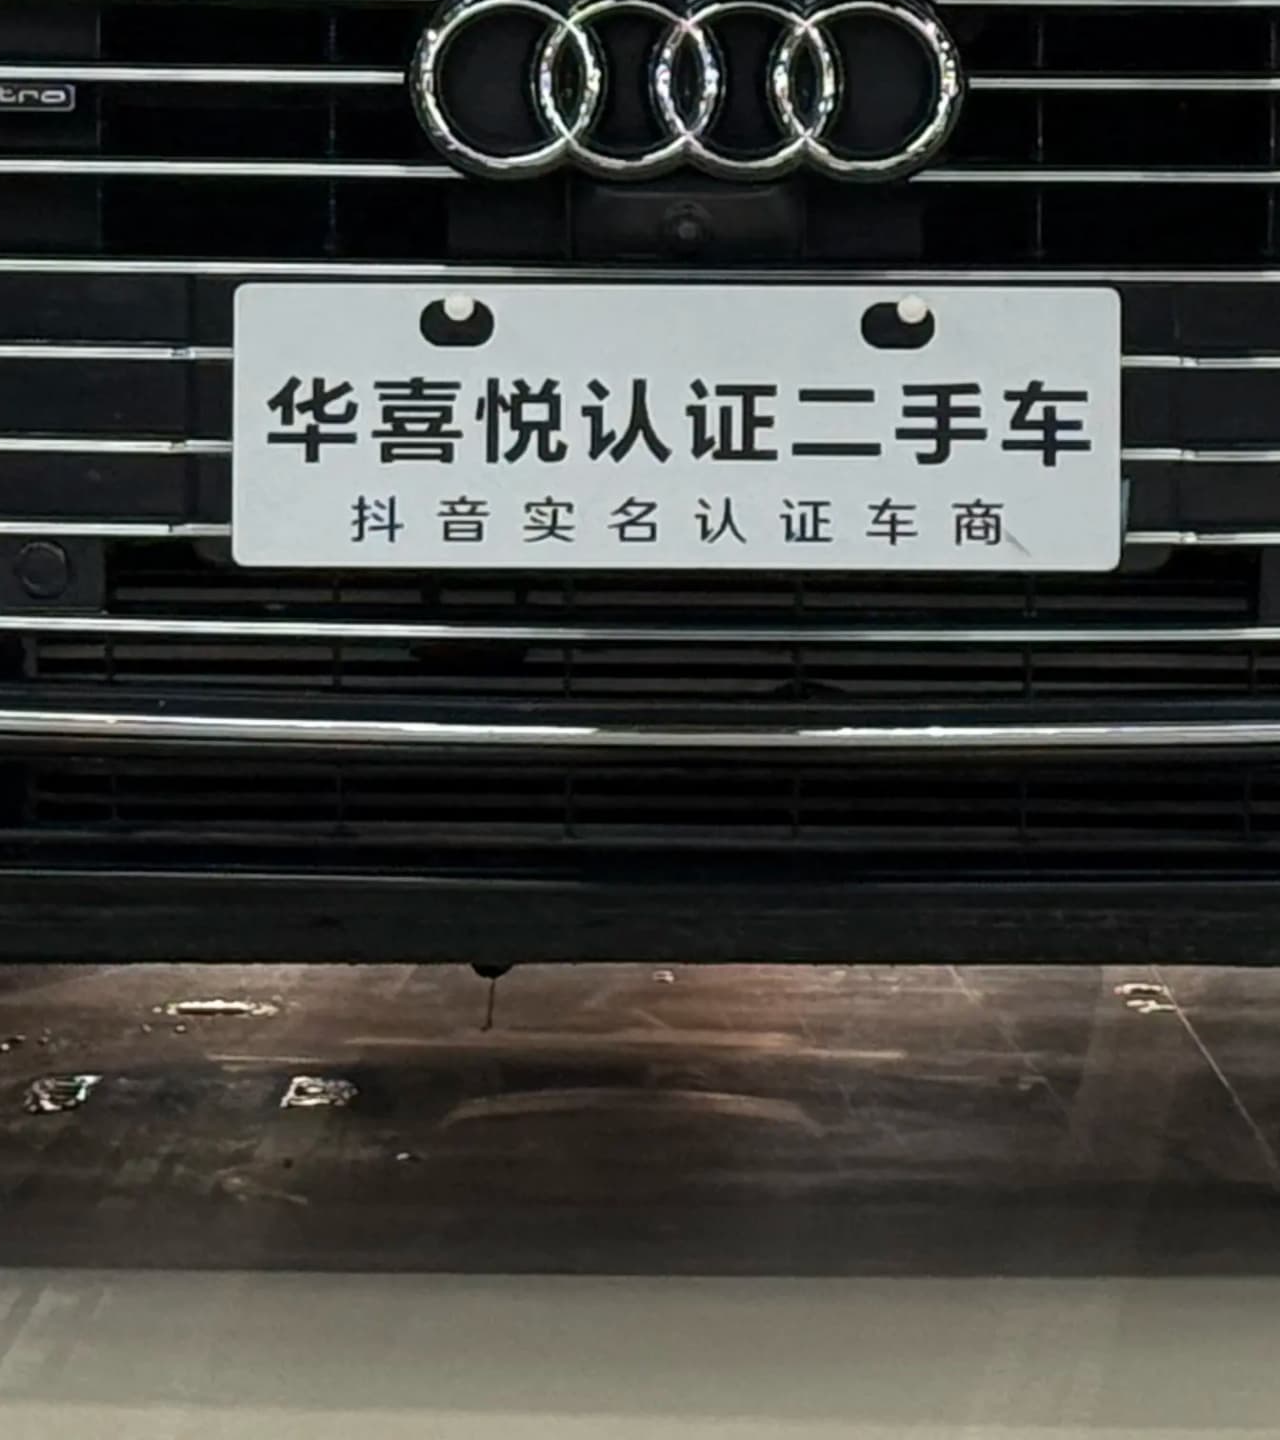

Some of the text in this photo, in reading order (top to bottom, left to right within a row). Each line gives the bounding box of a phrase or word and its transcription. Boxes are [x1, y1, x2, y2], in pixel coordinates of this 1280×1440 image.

[266, 376, 1094, 467] 华喜悦认证二手车
[350, 495, 1008, 546] 抖音实名认证车商
